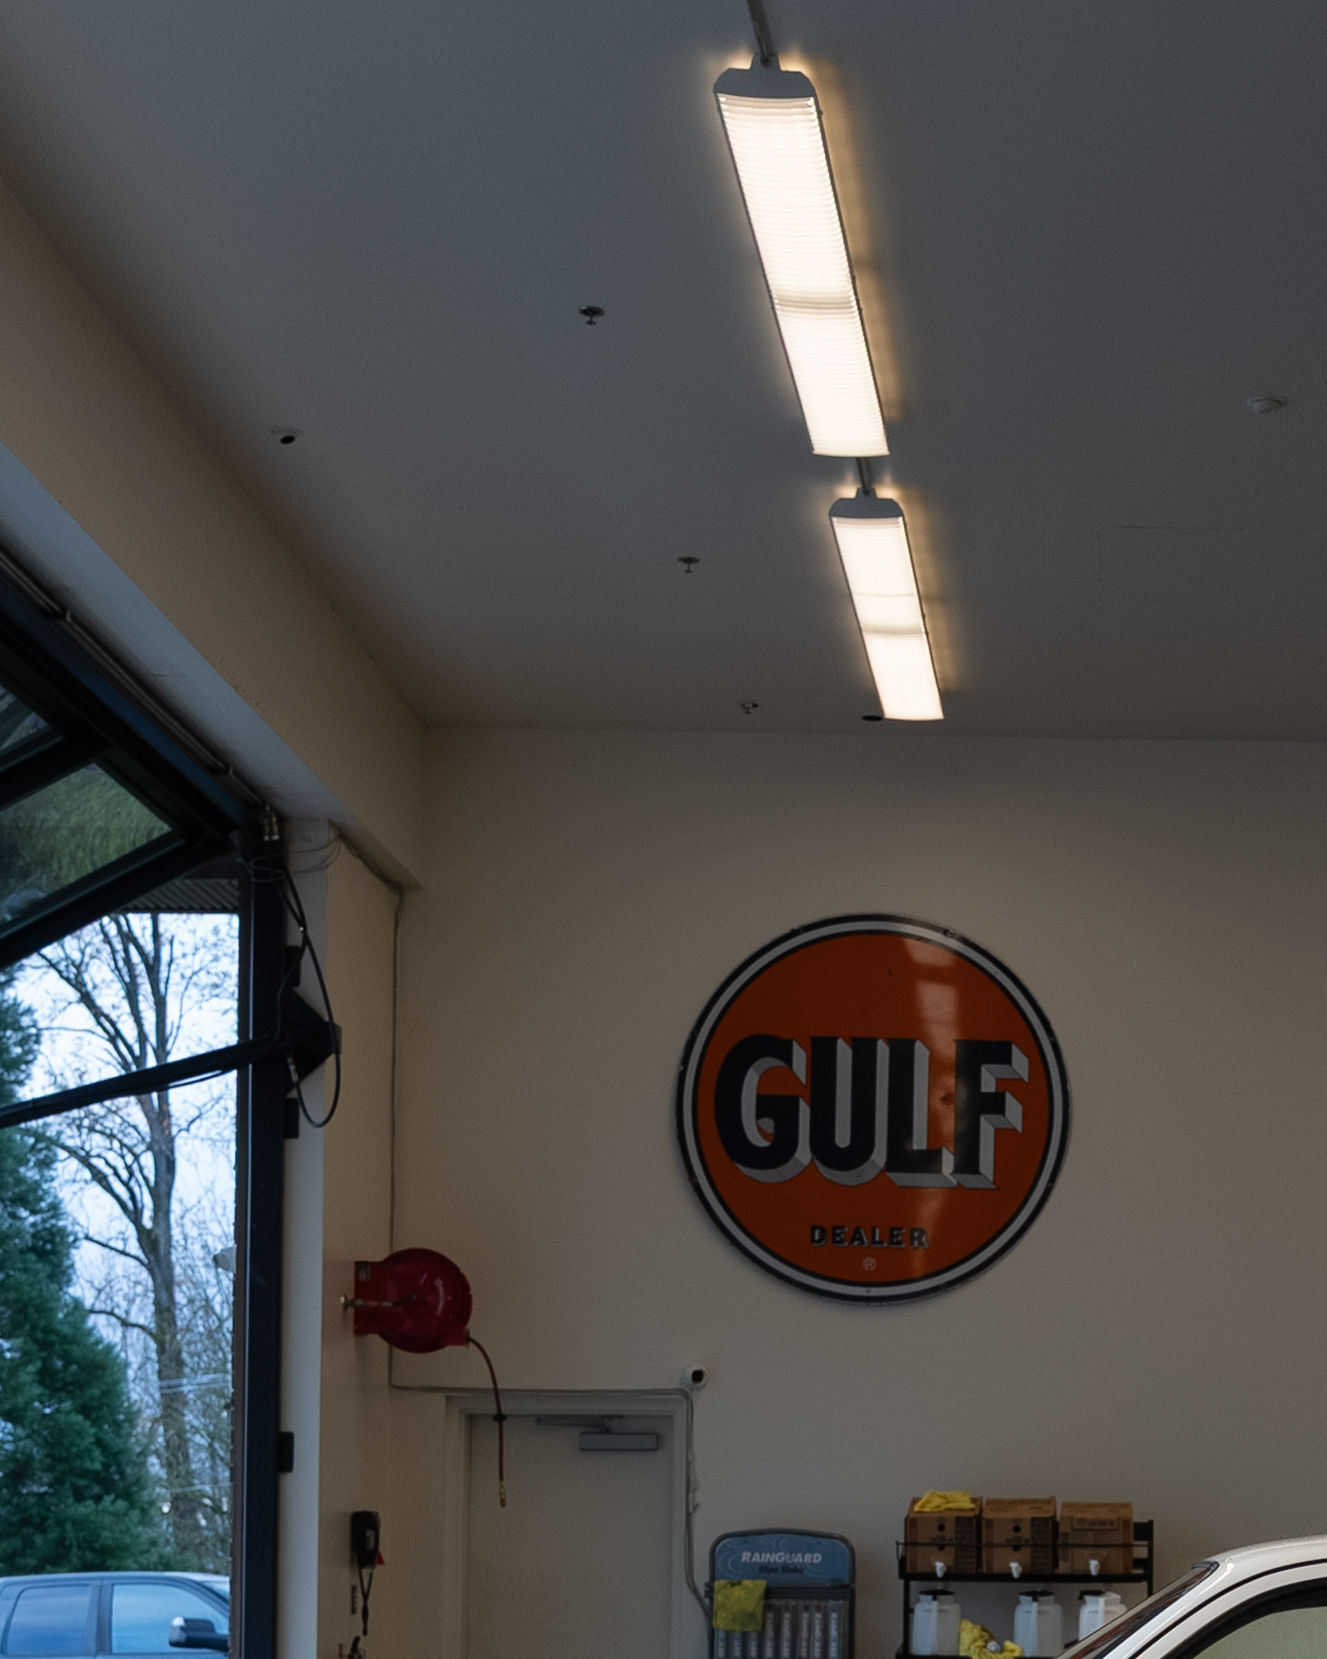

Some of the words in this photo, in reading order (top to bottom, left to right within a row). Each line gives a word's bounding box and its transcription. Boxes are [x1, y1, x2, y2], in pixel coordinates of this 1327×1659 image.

[714, 1033, 1029, 1189] GULF
[810, 1225, 930, 1249] DEALER
[741, 1551, 823, 1564] RAINGUARD
